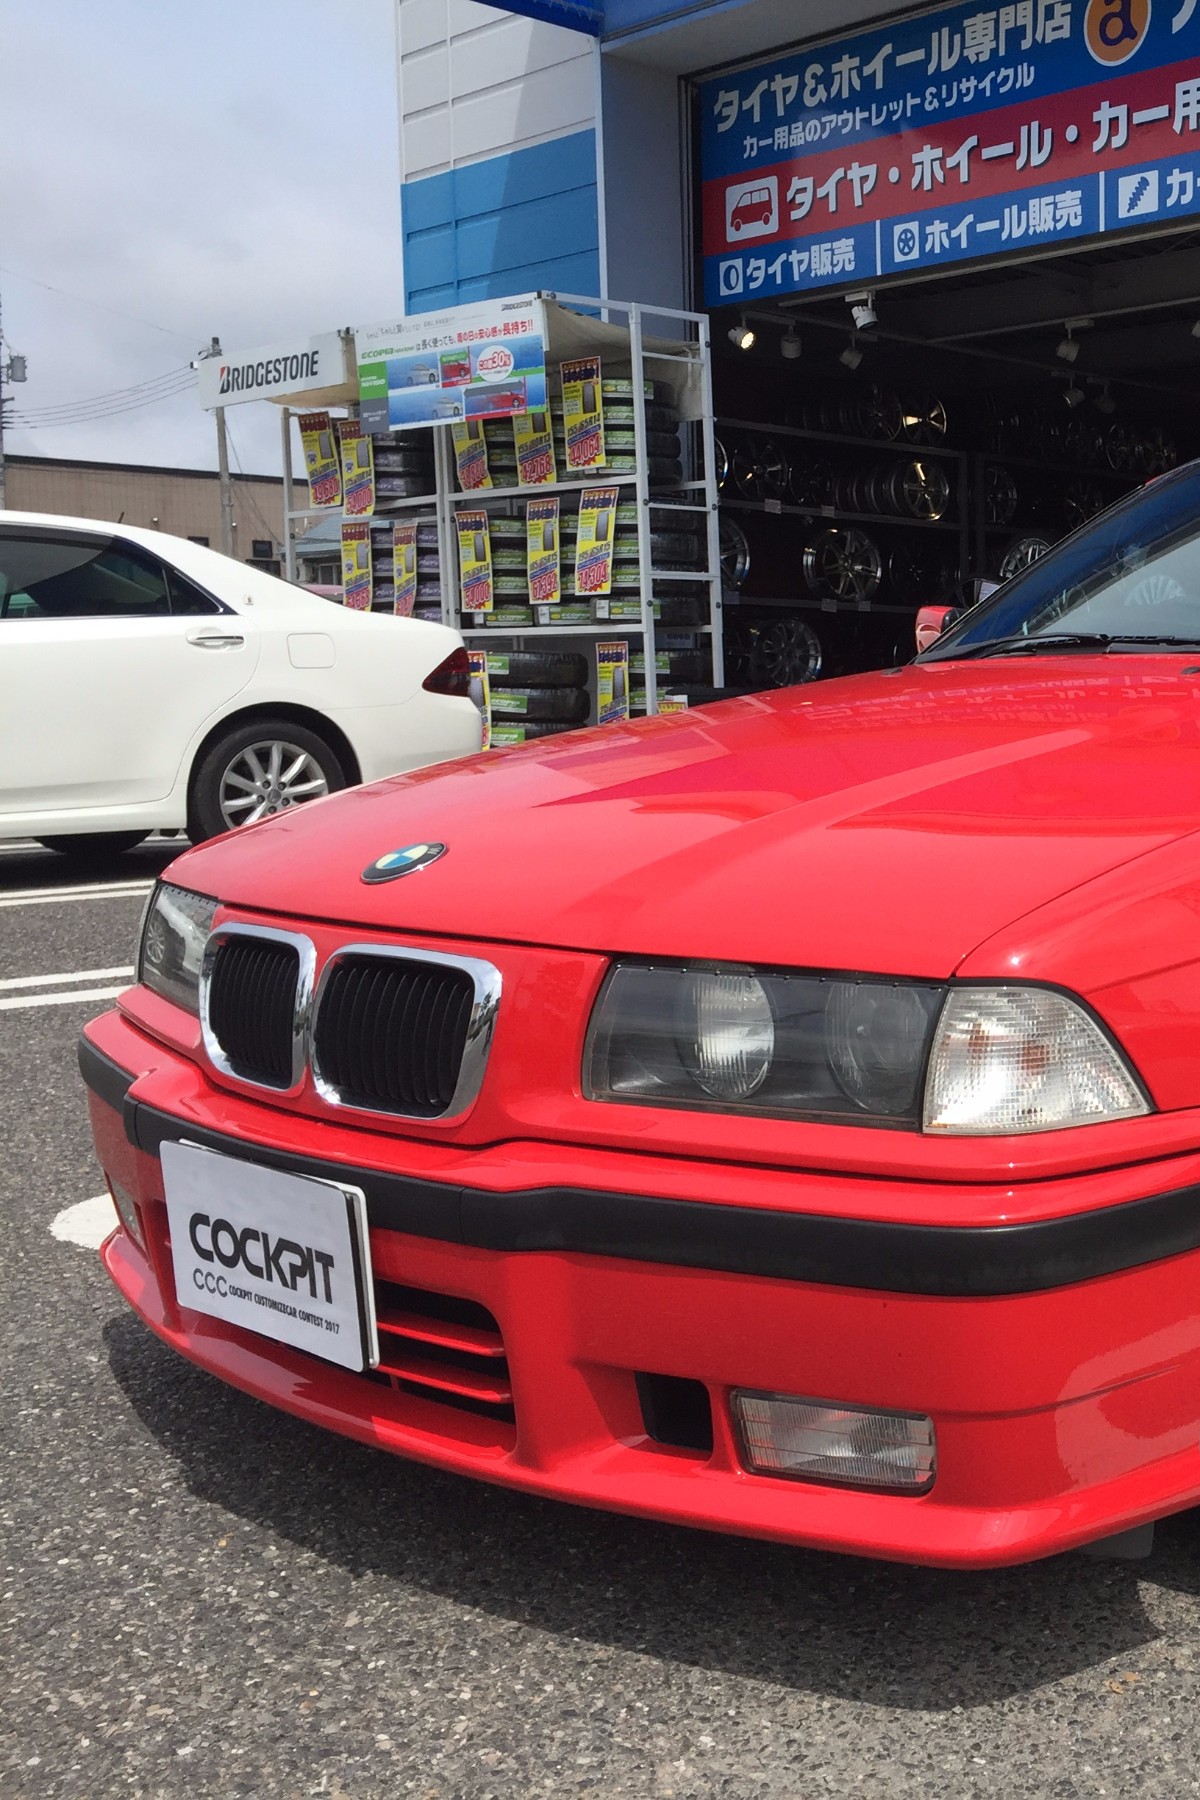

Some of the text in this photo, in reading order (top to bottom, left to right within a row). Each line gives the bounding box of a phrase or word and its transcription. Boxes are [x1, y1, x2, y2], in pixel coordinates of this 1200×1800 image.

[714, 0, 1071, 133] タイヤ&ホイール専門店
[742, 62, 1035, 159] カー用品のアウトレット&リサイクル
[924, 190, 1082, 254] ホイール販売
[746, 238, 855, 290] タイヤ販売
[219, 350, 319, 394] BRIDGESTONE
[189, 1213, 335, 1304] COCKPIT
[193, 1268, 228, 1298] CCC
[229, 1284, 253, 1302] COCKPIT
[298, 1310, 324, 1328] CONTEST
[324, 1319, 340, 1334] 2017
